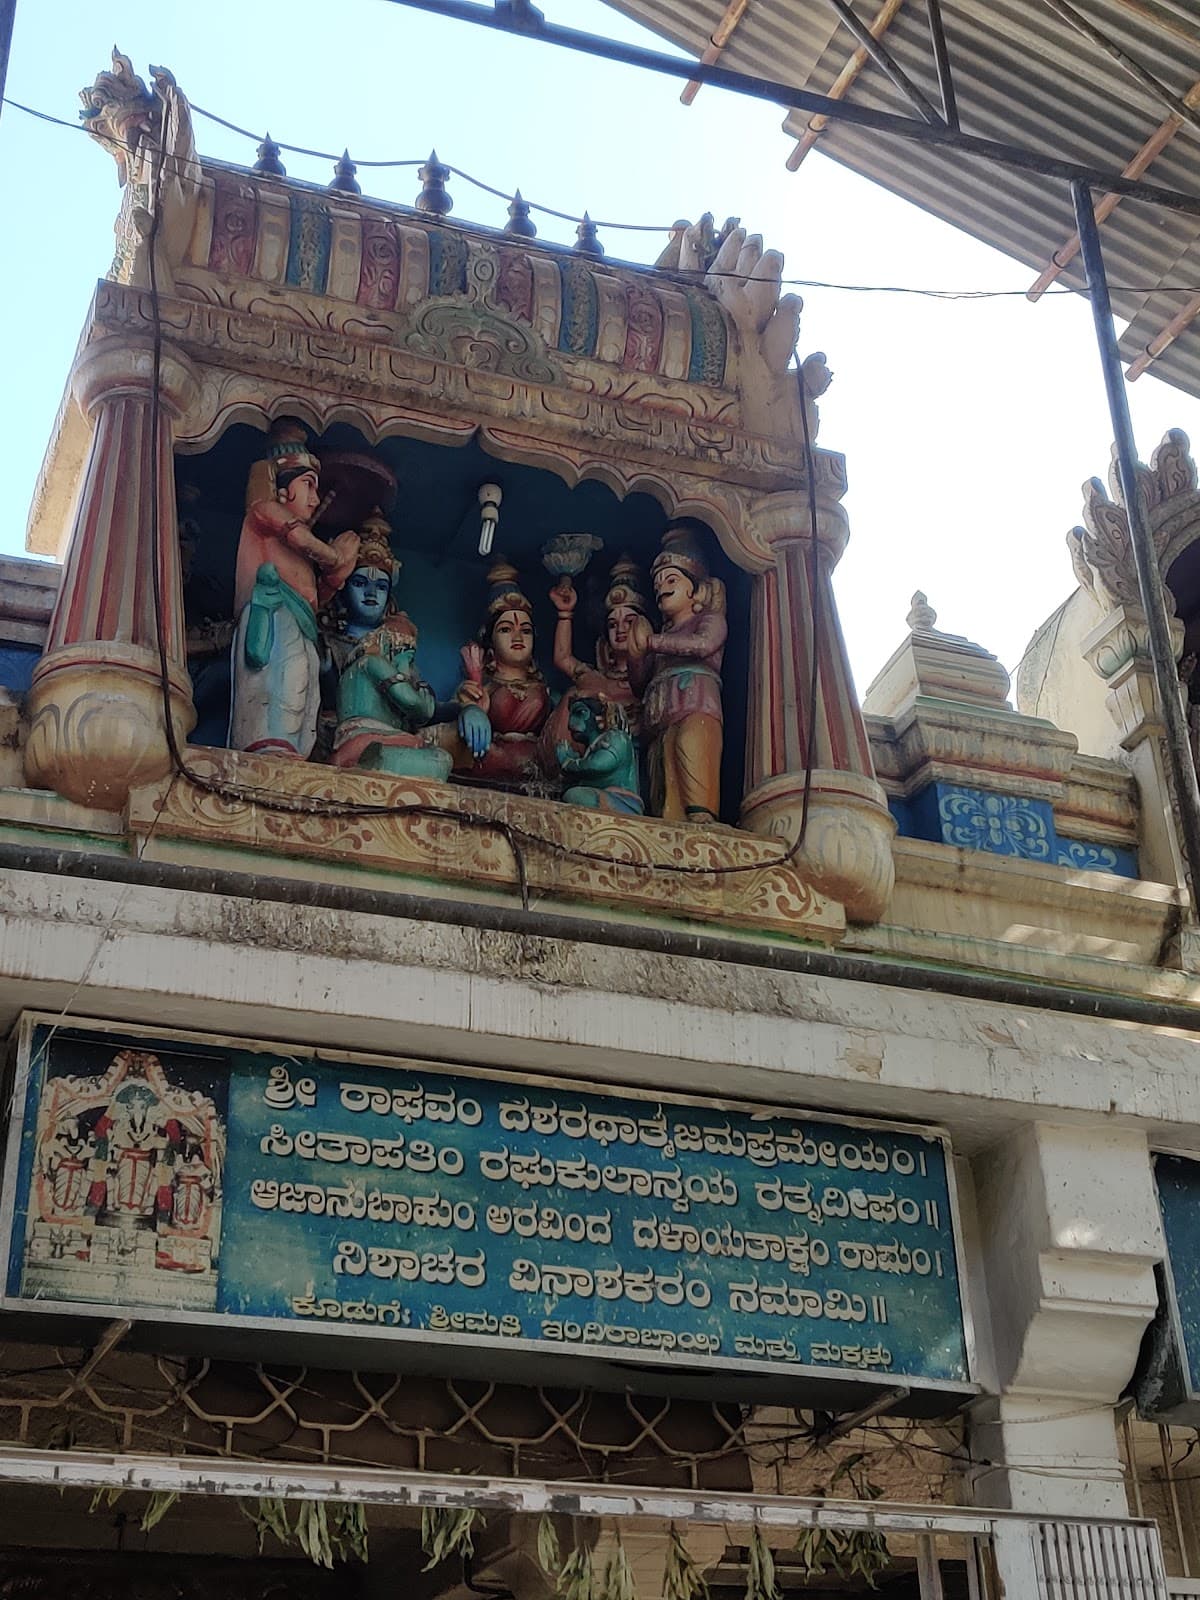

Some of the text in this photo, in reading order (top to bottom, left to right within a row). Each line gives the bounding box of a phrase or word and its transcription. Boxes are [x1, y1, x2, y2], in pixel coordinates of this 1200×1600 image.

[263, 1066, 317, 1110] ಶ್ರೀ
[339, 1081, 483, 1126] ರಾಘವಂ
[260, 1124, 464, 1175] ಸೀತಾಪತಿಂ
[479, 1144, 738, 1213] ರಘುಕುಲಾನ್ವಯ
[250, 1179, 476, 1231] ಆಜಾನುಬಾಹುಂ
[486, 1199, 612, 1244] ಅರವಿಂದ
[632, 1212, 830, 1276] ದಳಾಯತಾಕ್ಷಂ
[332, 1240, 486, 1287] ನಿಶಾಚರ
[508, 1259, 712, 1308] ವಿನಾಶಕರಂ
[428, 1304, 522, 1335] ಶ್ರೀಮತಿ
[734, 1335, 801, 1361] ಮತ್ತು
[810, 1340, 893, 1369] ಮಕ್ಕಳು
